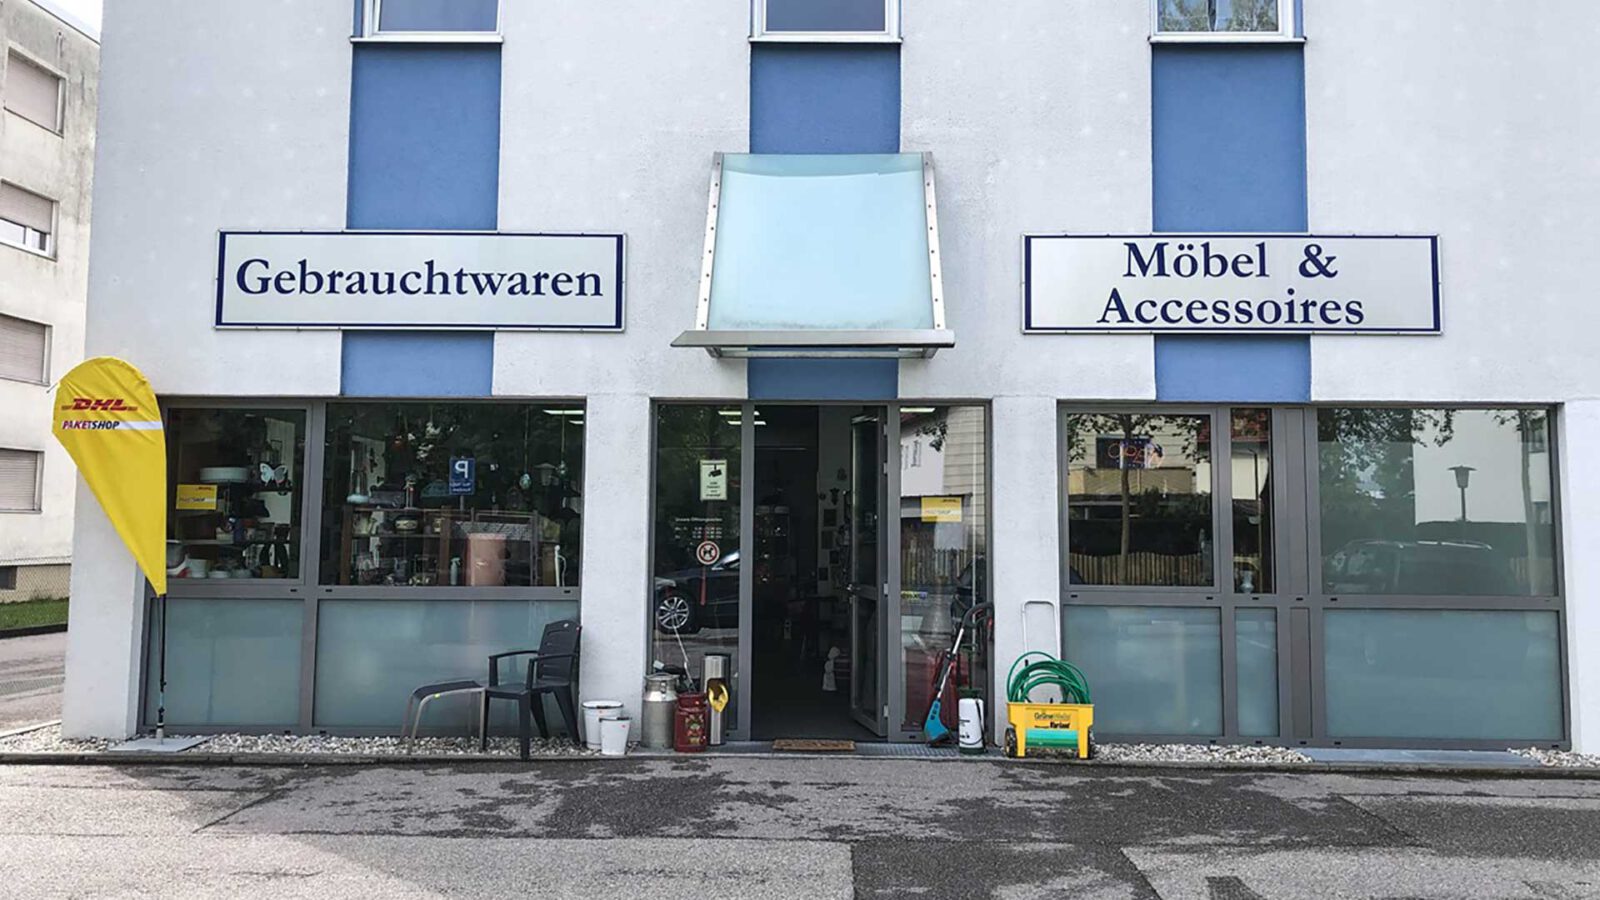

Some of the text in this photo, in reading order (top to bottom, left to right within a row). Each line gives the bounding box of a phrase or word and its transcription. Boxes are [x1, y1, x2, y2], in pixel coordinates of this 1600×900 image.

[235, 258, 603, 297] Gebrauchtwaren
[1122, 241, 1339, 279] Möbel &
[1096, 287, 1365, 325] Accessoires
[71, 397, 128, 411] DHL
[62, 420, 120, 430] PAKETSHOP
